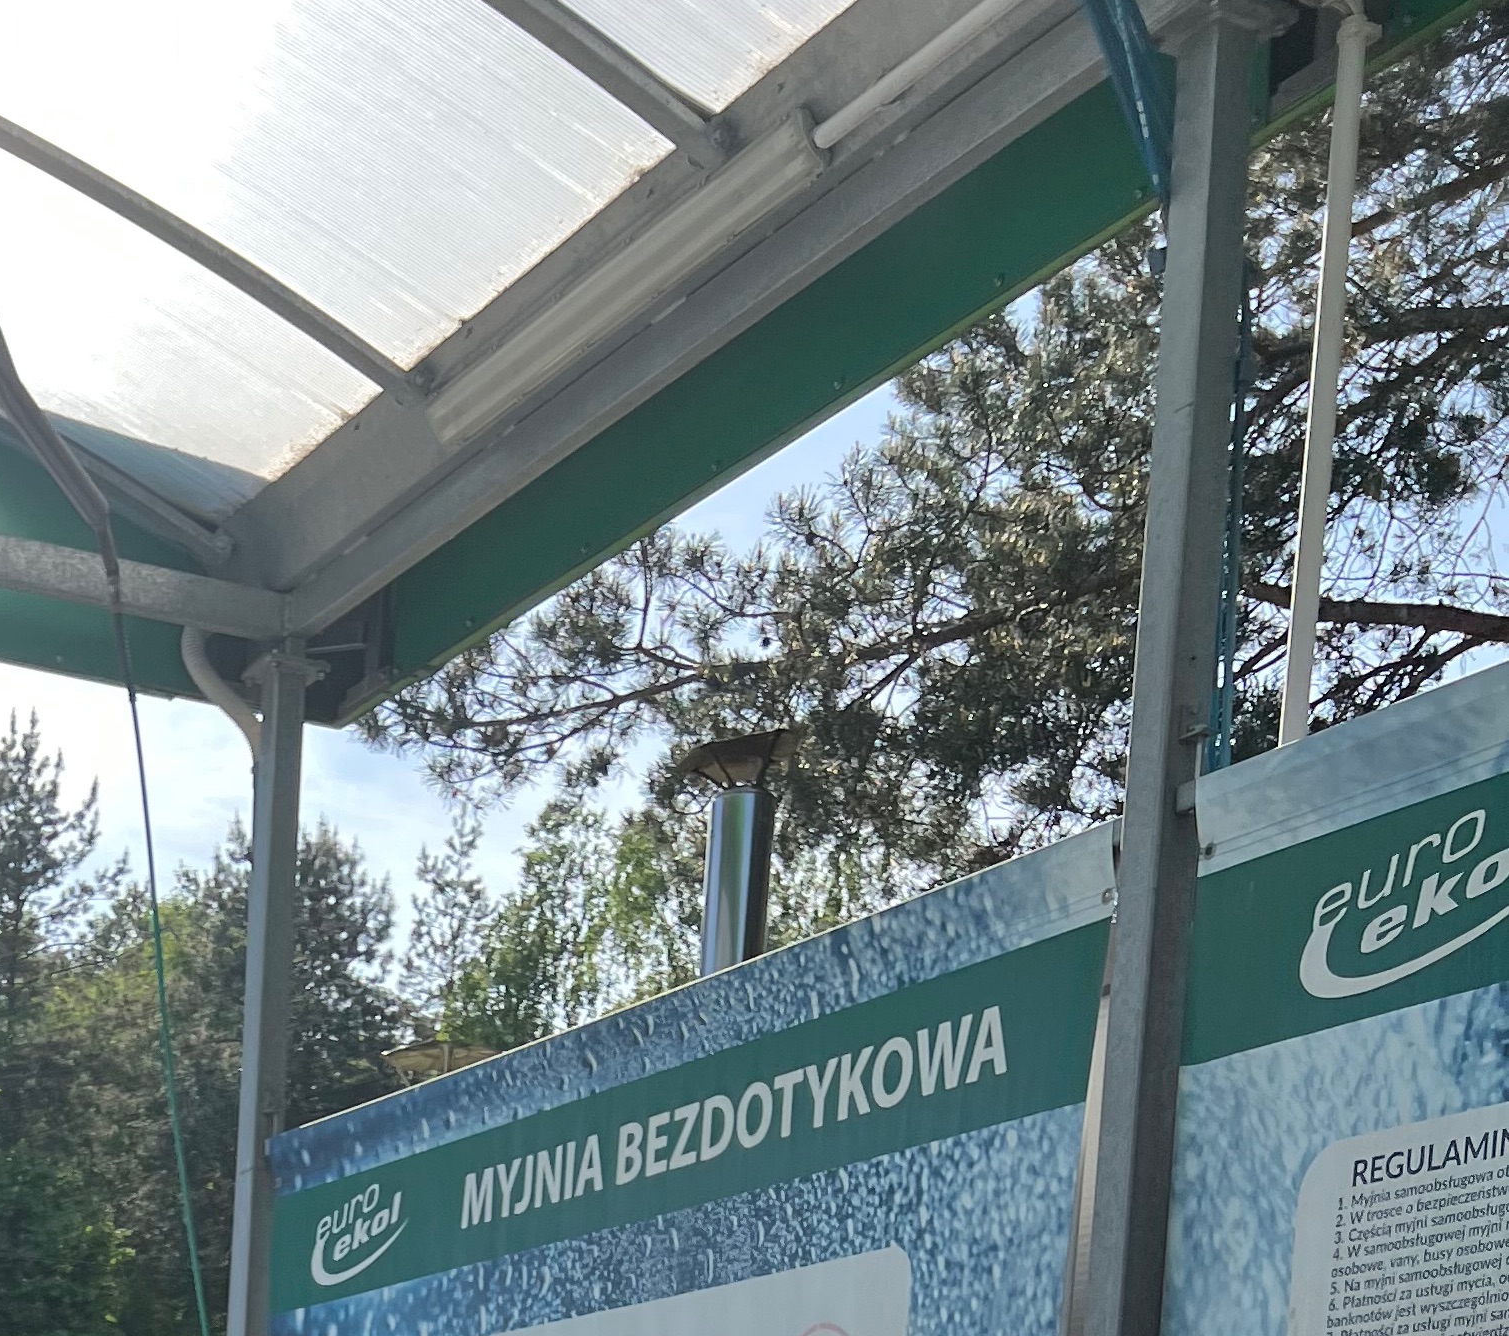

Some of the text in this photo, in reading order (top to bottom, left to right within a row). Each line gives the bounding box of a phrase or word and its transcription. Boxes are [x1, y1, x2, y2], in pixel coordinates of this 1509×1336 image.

[1313, 809, 1486, 930] euro
[460, 1005, 1007, 1209] MYJNIA BEZDOTYKOWA
[1338, 1170, 1493, 1210] 1. Myjnia samoobsługowa
[316, 1183, 380, 1243] euro
[333, 1191, 402, 1261] ekol
[1334, 1231, 1344, 1244] 3.
[1348, 1223, 1391, 1241] Częścią
[1395, 1217, 1428, 1234] myjni
[1335, 1215, 1345, 1227] 2.
[1350, 1211, 1364, 1224] W
[1367, 1205, 1402, 1221] trosce
[1406, 1204, 1413, 1213] o
[1332, 1248, 1343, 1260] 4.
[1347, 1245, 1361, 1258] W
[1364, 1226, 1465, 1255] samoobsługowej
[1469, 1218, 1503, 1238] myjni
[1424, 1248, 1453, 1262] busy
[1329, 1274, 1496, 1311] 6. Płatności za usługi mycia,
[1330, 1282, 1339, 1295] 5.
[1344, 1279, 1360, 1292] Na
[1364, 1273, 1395, 1289] myjni
[1399, 1254, 1502, 1283] samoobsługowej
[1327, 1308, 1391, 1328] banknotów
[1394, 1303, 1416, 1321] jest
[1397, 1324, 1409, 1334] za
[1413, 1316, 1450, 1332] usługi
[1454, 1309, 1487, 1327] myjni
